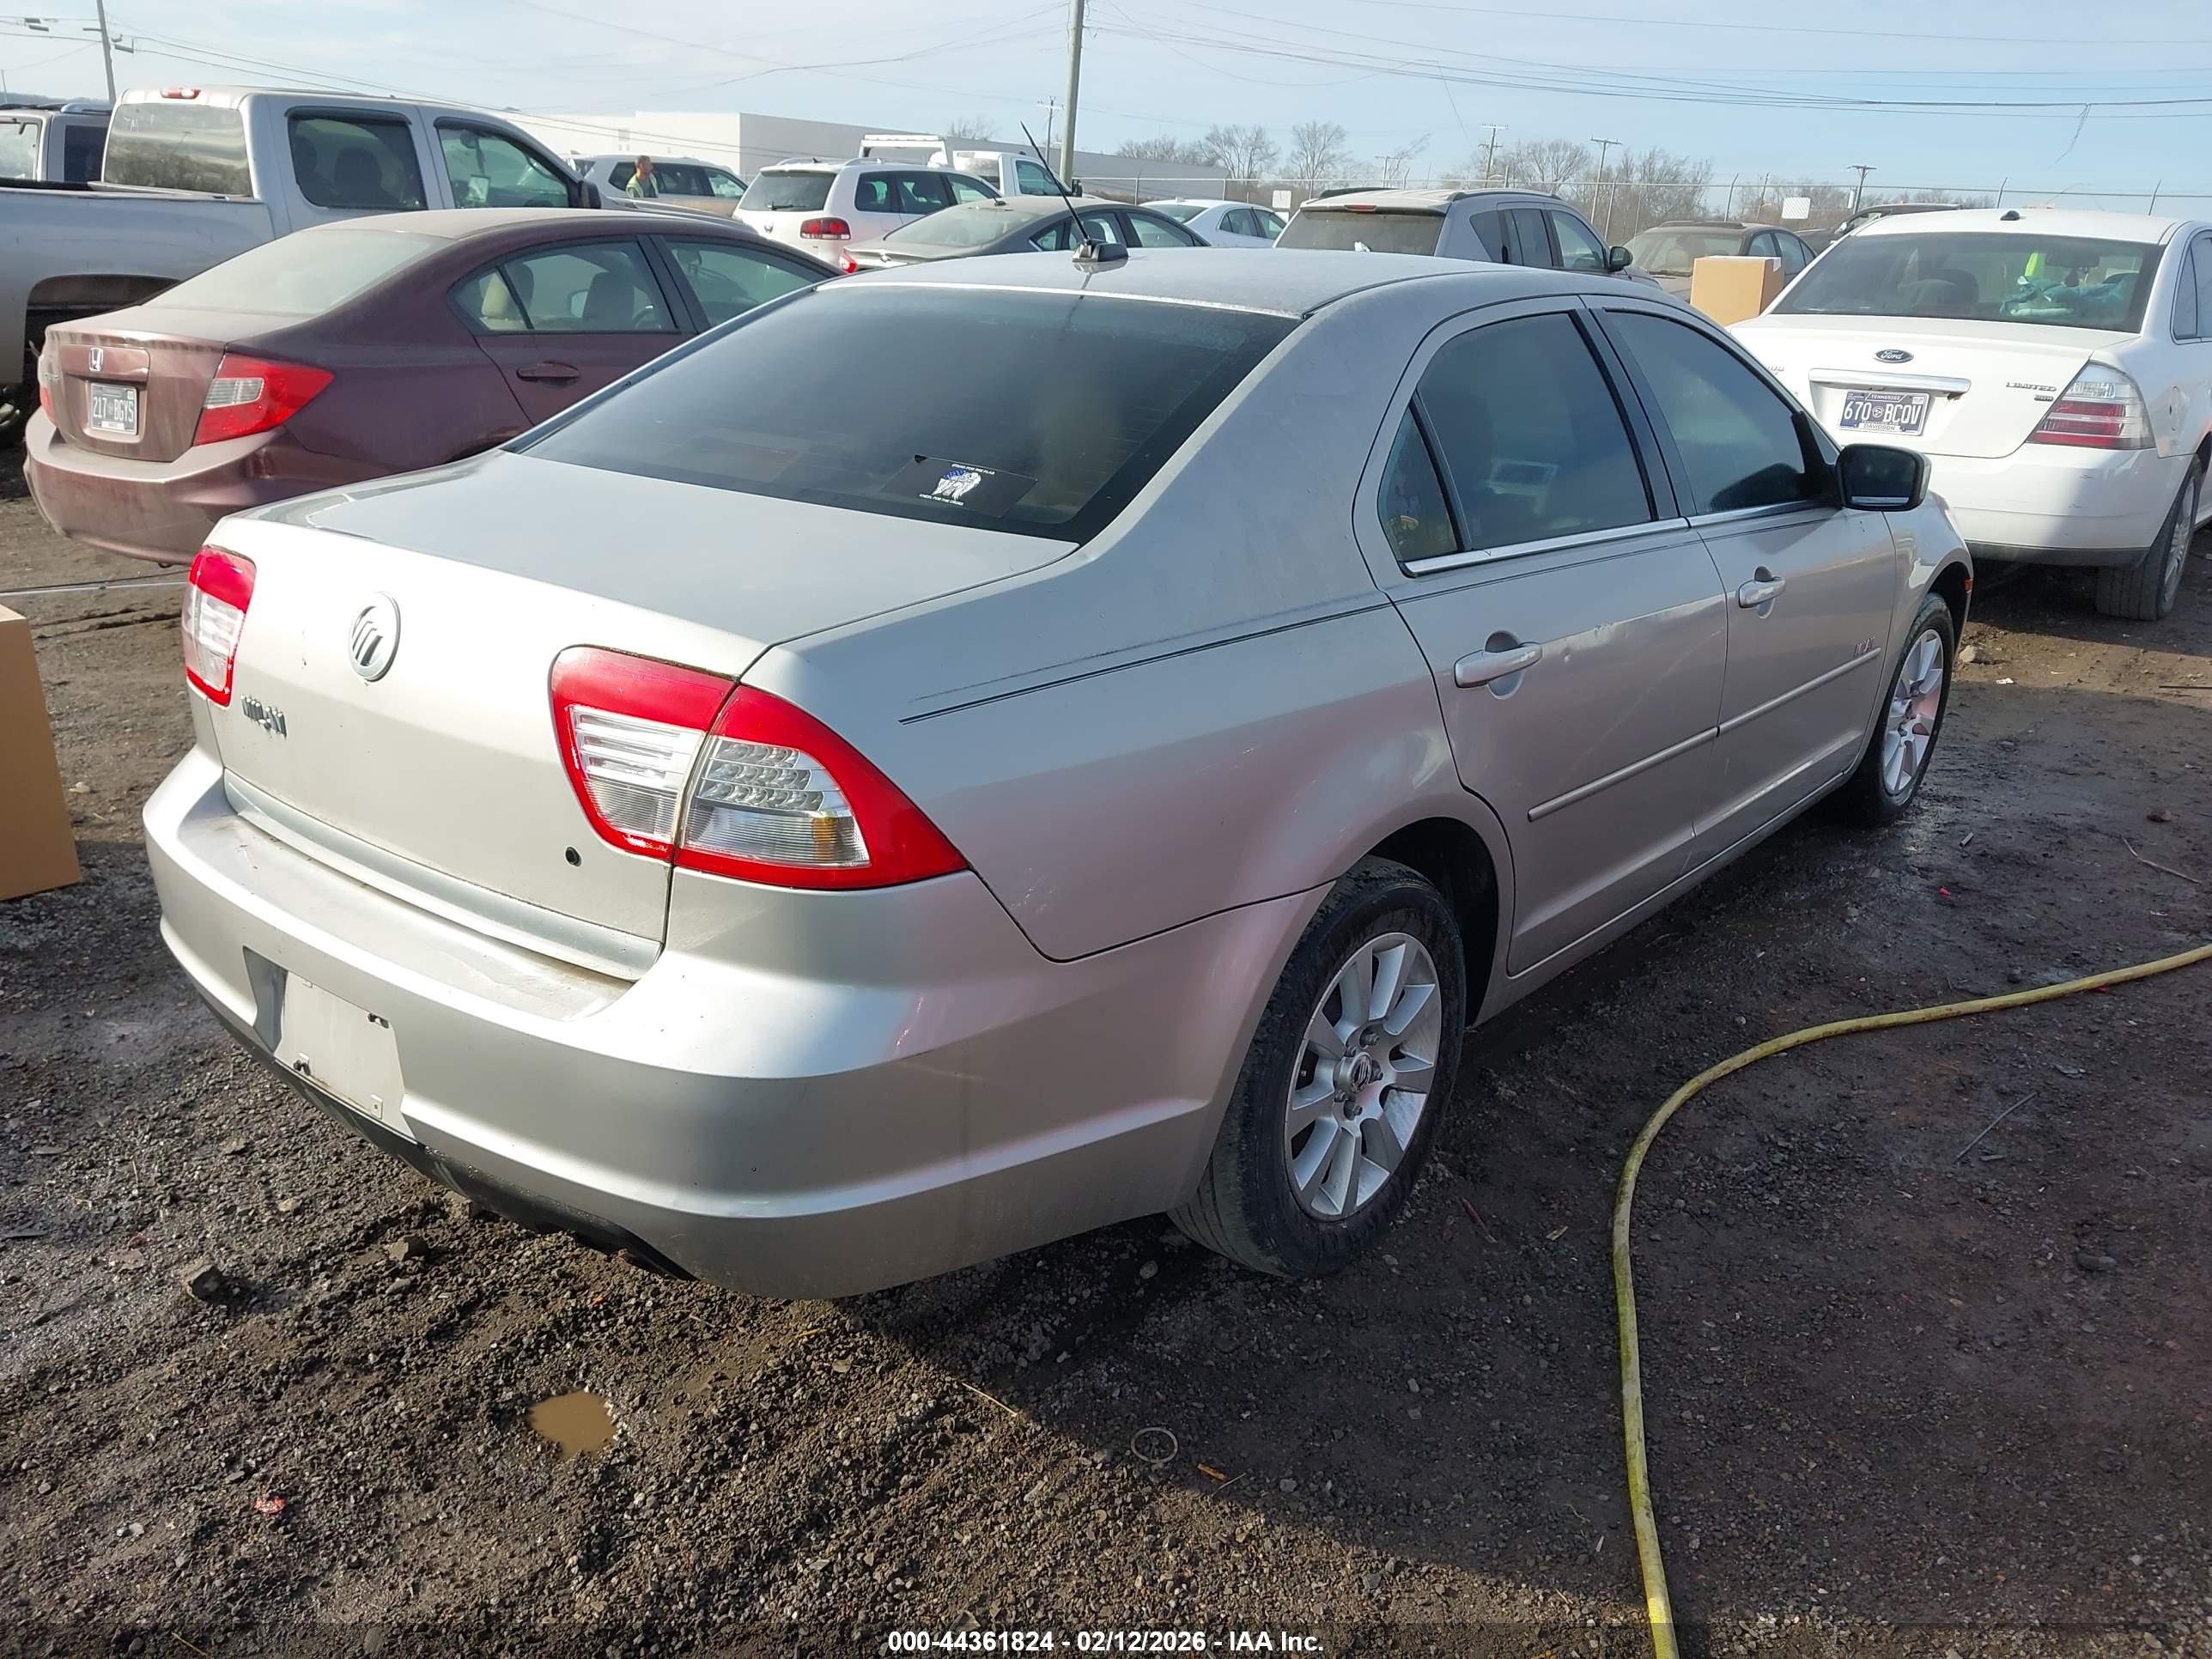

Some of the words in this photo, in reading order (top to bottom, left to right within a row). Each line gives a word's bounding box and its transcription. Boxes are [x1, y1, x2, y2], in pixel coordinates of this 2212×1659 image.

[2006, 382, 2057, 392] LIMITED
[94, 397, 107, 419] 217
[114, 398, 133, 422] BGYS
[1844, 400, 1872, 421] 670
